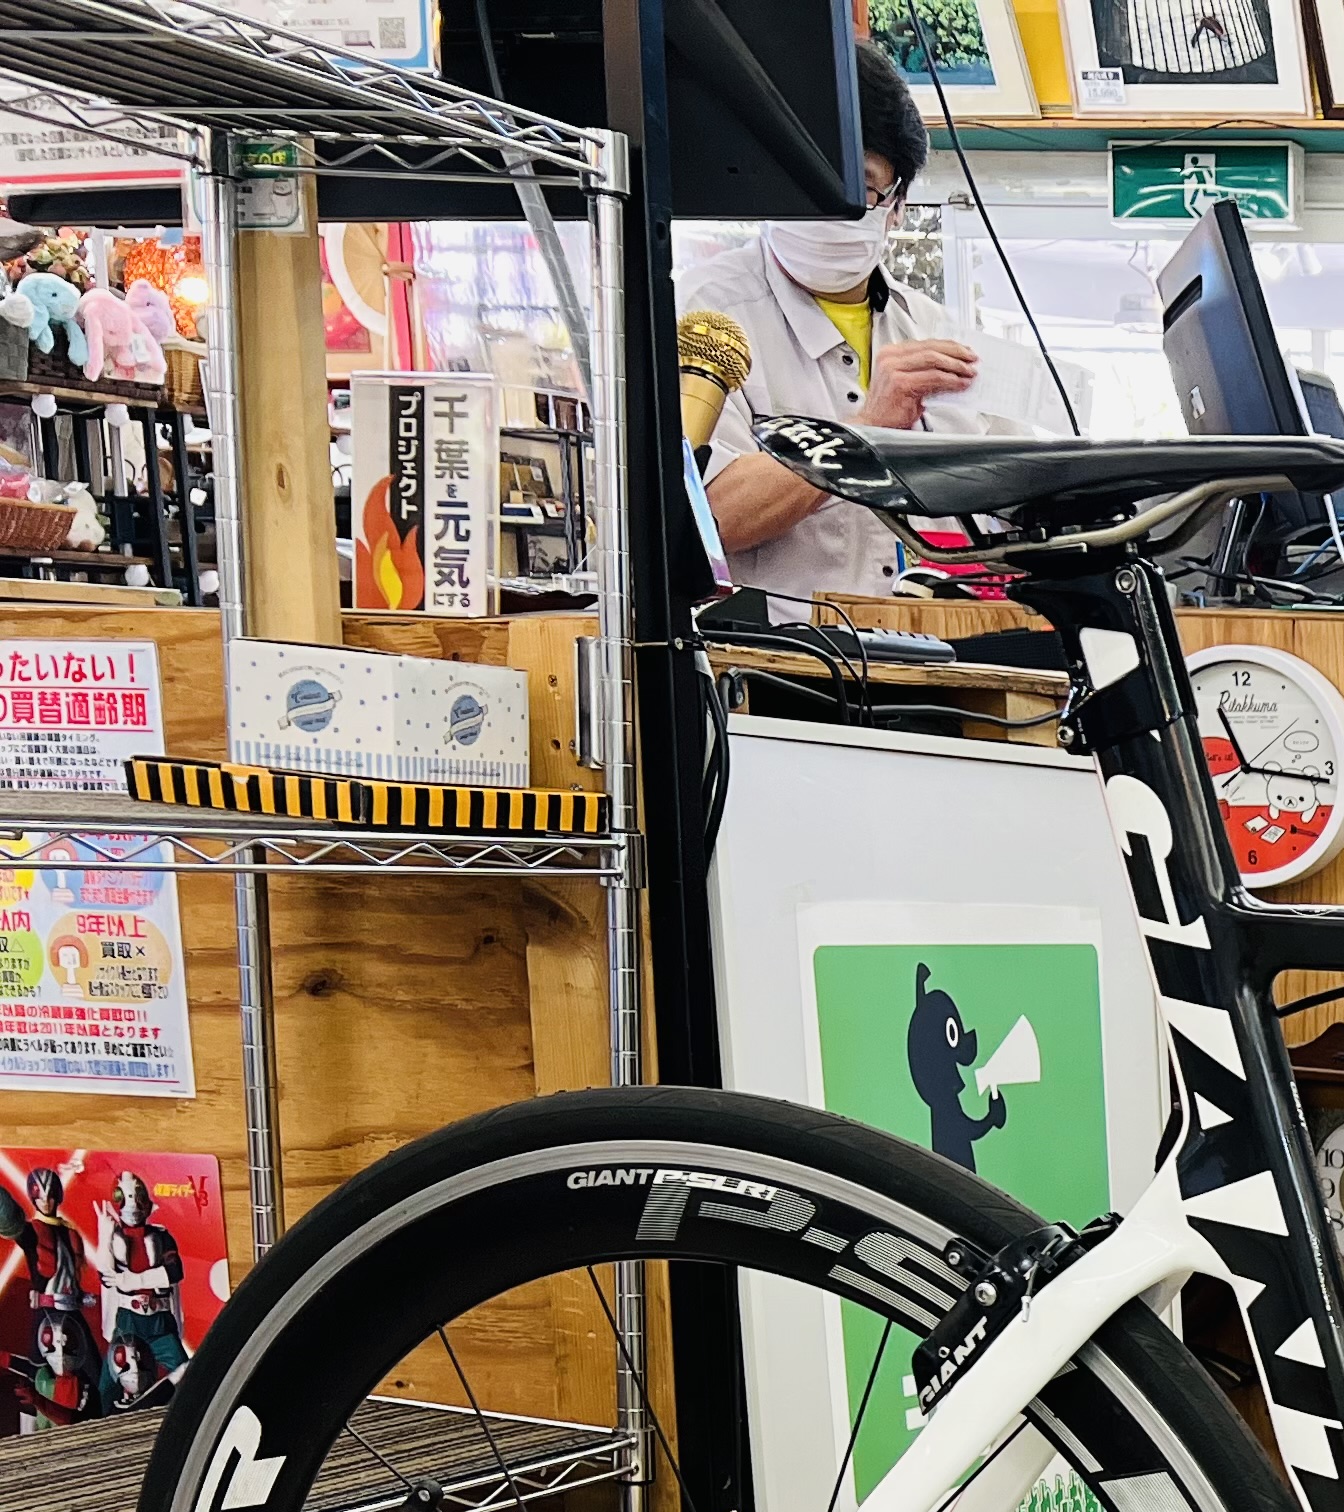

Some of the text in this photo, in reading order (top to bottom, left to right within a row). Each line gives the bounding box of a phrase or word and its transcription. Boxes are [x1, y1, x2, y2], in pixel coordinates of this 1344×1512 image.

[397, 392, 421, 521] プロジェクト
[0, 651, 136, 683] たいない！
[1232, 672, 1252, 687] 12
[1218, 690, 1278, 712] Rilakkuma
[1325, 762, 1334, 776] 3
[1247, 851, 1257, 865] 6
[77, 914, 148, 938] 9年以上
[567, 1168, 653, 1190] GIANT
[1331, 1209, 1344, 1231] 8
[918, 1316, 988, 1413] GIANT
